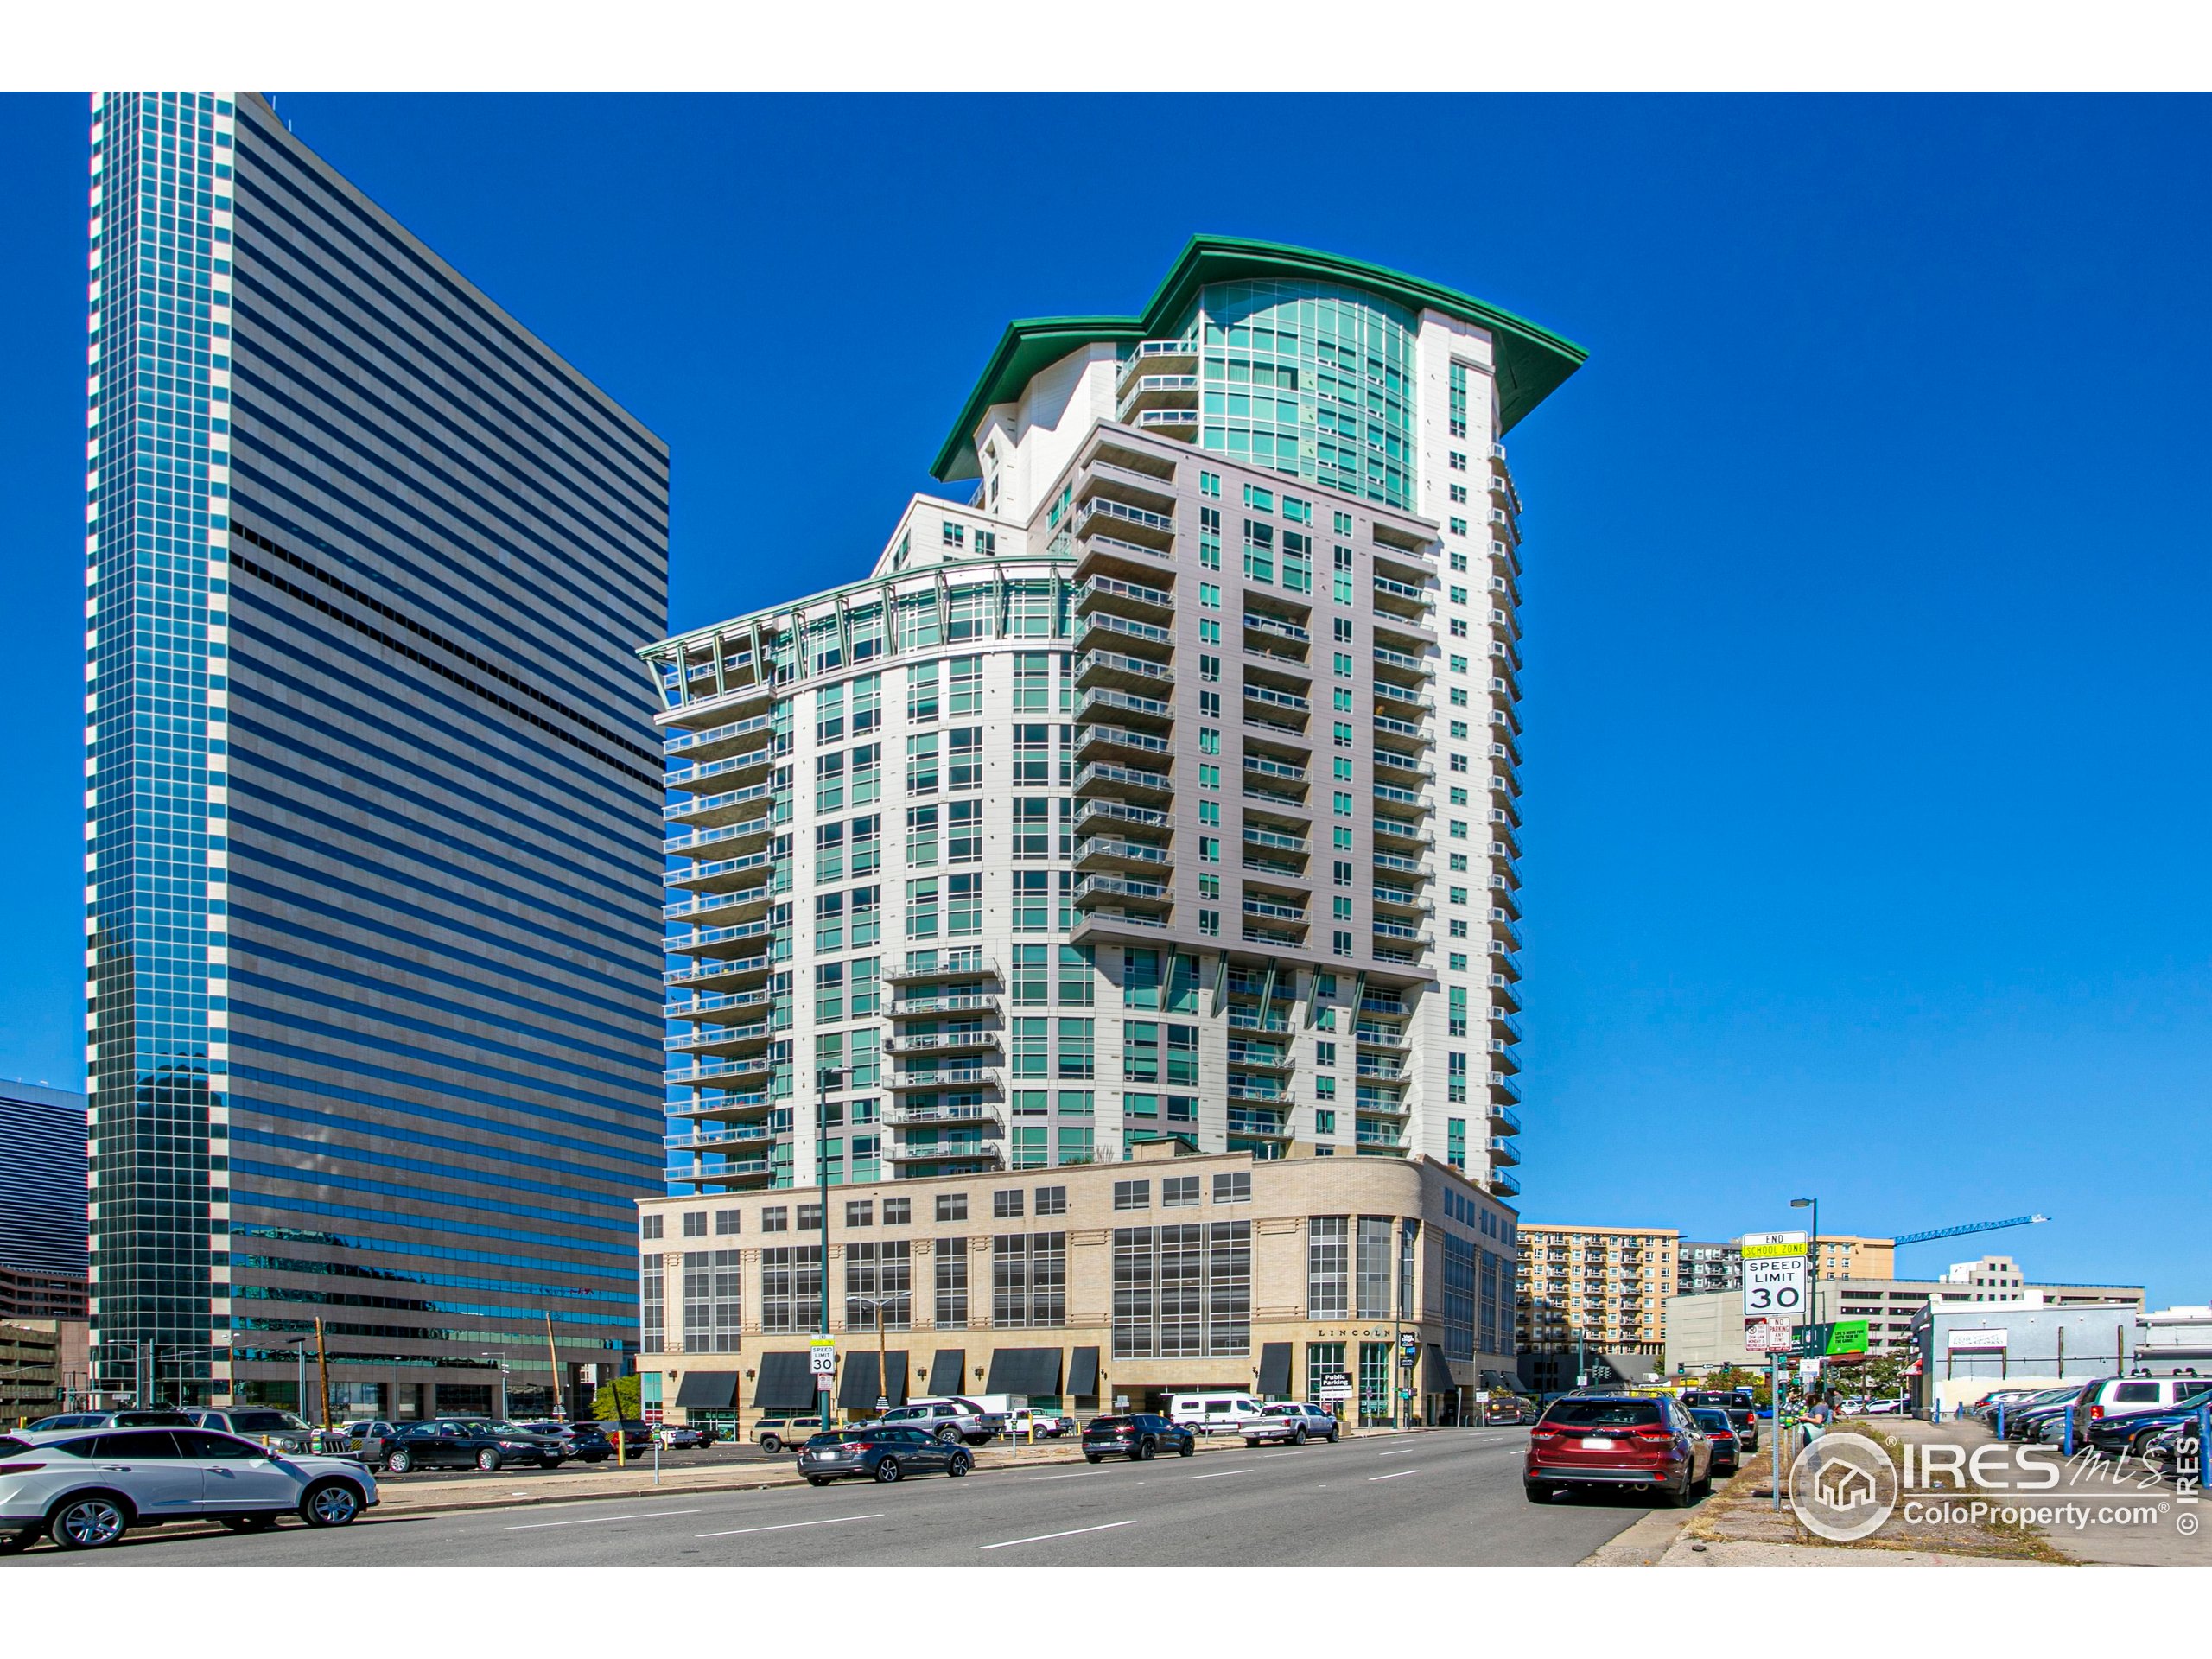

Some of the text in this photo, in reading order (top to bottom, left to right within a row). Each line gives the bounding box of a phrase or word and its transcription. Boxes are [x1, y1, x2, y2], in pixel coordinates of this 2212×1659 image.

[1765, 1234, 1783, 1243] END
[1746, 1244, 1803, 1255] SCHOOL ZONE
[1750, 1261, 1801, 1271] SPEED
[1755, 1272, 1795, 1282] LIMIT
[1750, 1287, 1799, 1308] 30
[813, 1359, 831, 1369] 30
